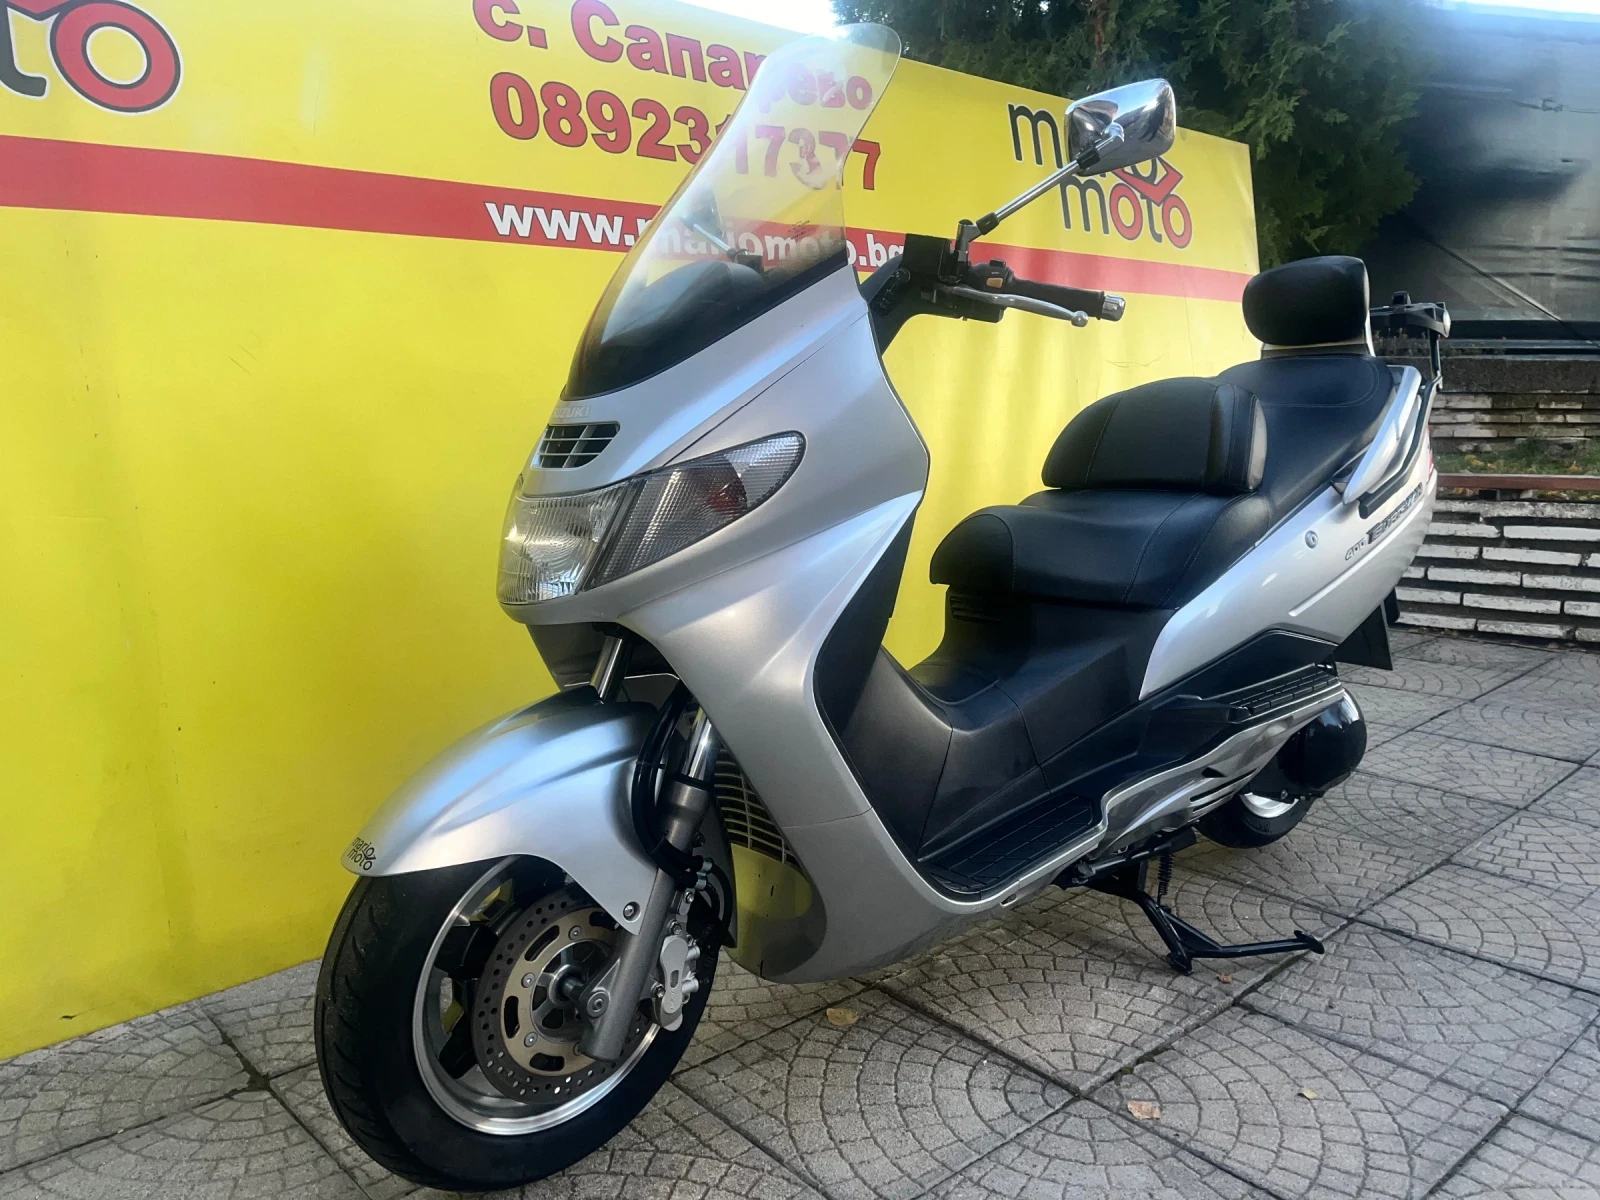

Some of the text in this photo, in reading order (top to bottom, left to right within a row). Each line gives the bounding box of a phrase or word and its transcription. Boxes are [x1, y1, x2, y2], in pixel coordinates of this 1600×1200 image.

[490, 71, 881, 190] 0892317377
[1060, 175, 1193, 248] moto
[552, 405, 590, 419] UZUKI
[351, 837, 375, 857] mario
[347, 848, 373, 871] moto
